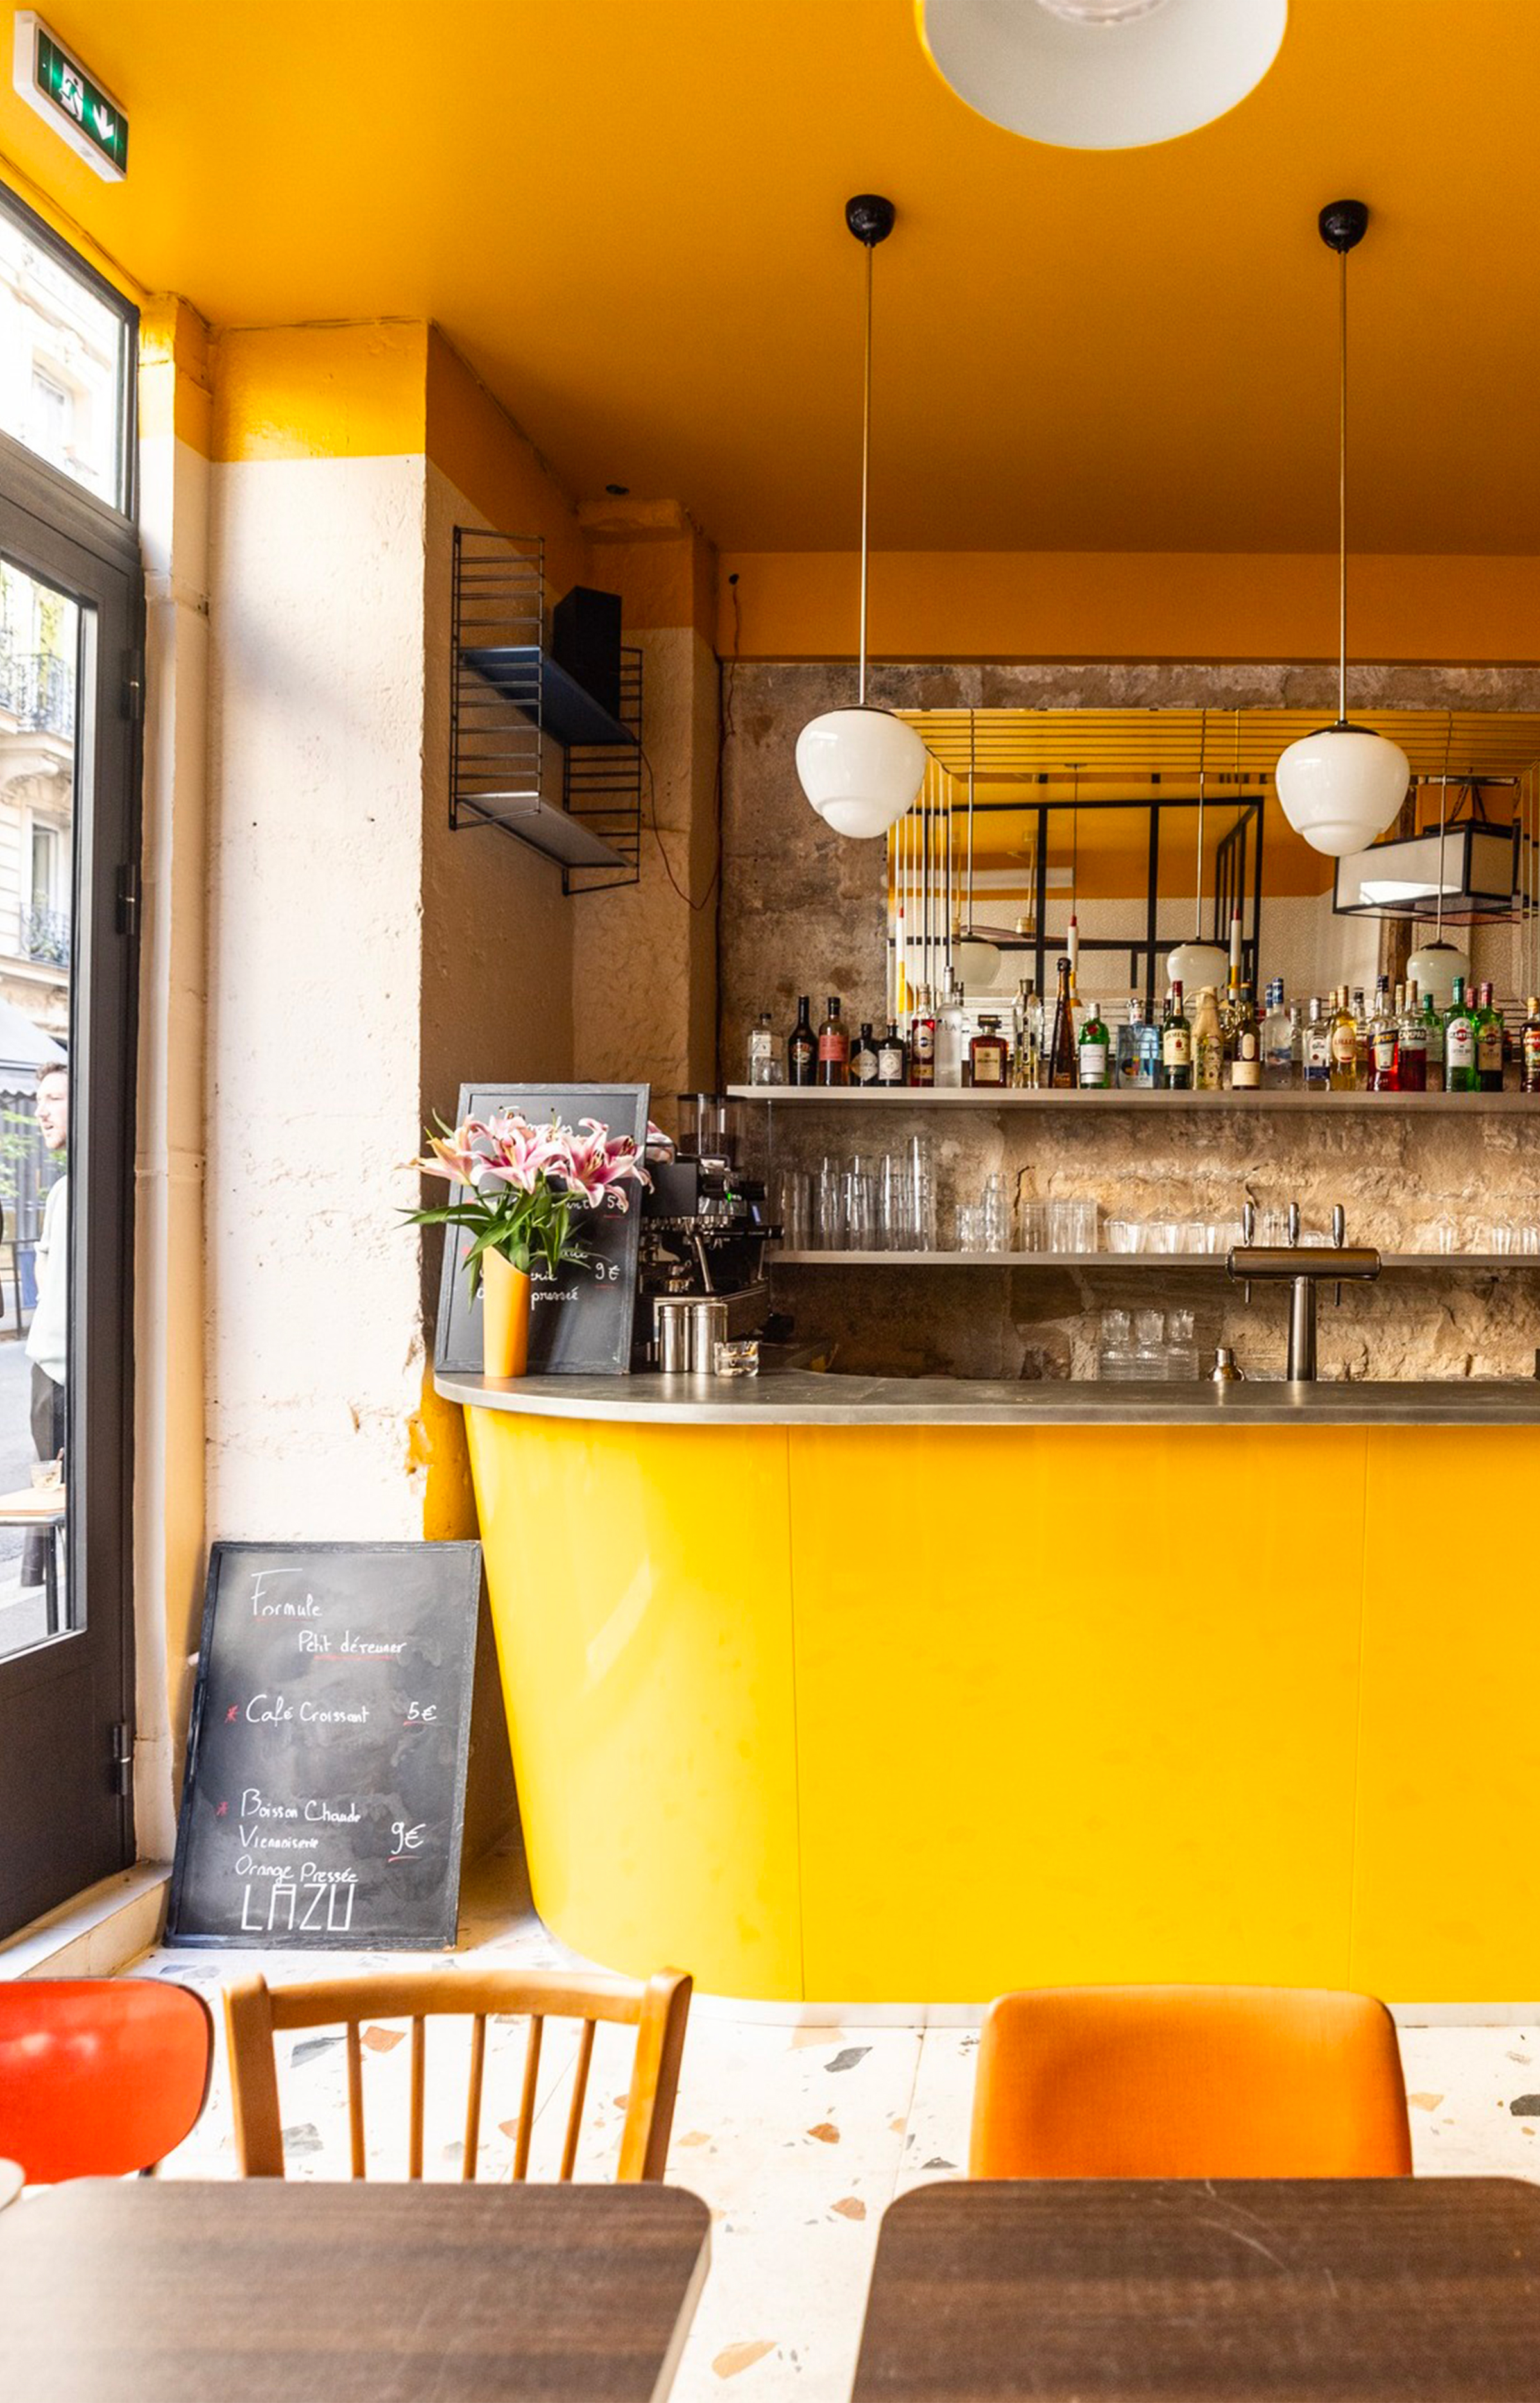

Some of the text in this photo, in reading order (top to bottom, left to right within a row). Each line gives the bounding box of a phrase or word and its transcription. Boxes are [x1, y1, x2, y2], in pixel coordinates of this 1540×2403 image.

[251, 1568, 322, 1616] Formule
[299, 1630, 331, 1652] Petit
[246, 1694, 436, 1727] Café Croissant 5€
[241, 1789, 361, 1823] Boisson Chaude
[391, 1822, 426, 1854] 9€
[235, 1854, 359, 1884] Orange Pressée
[241, 1884, 355, 1931] LAZU
